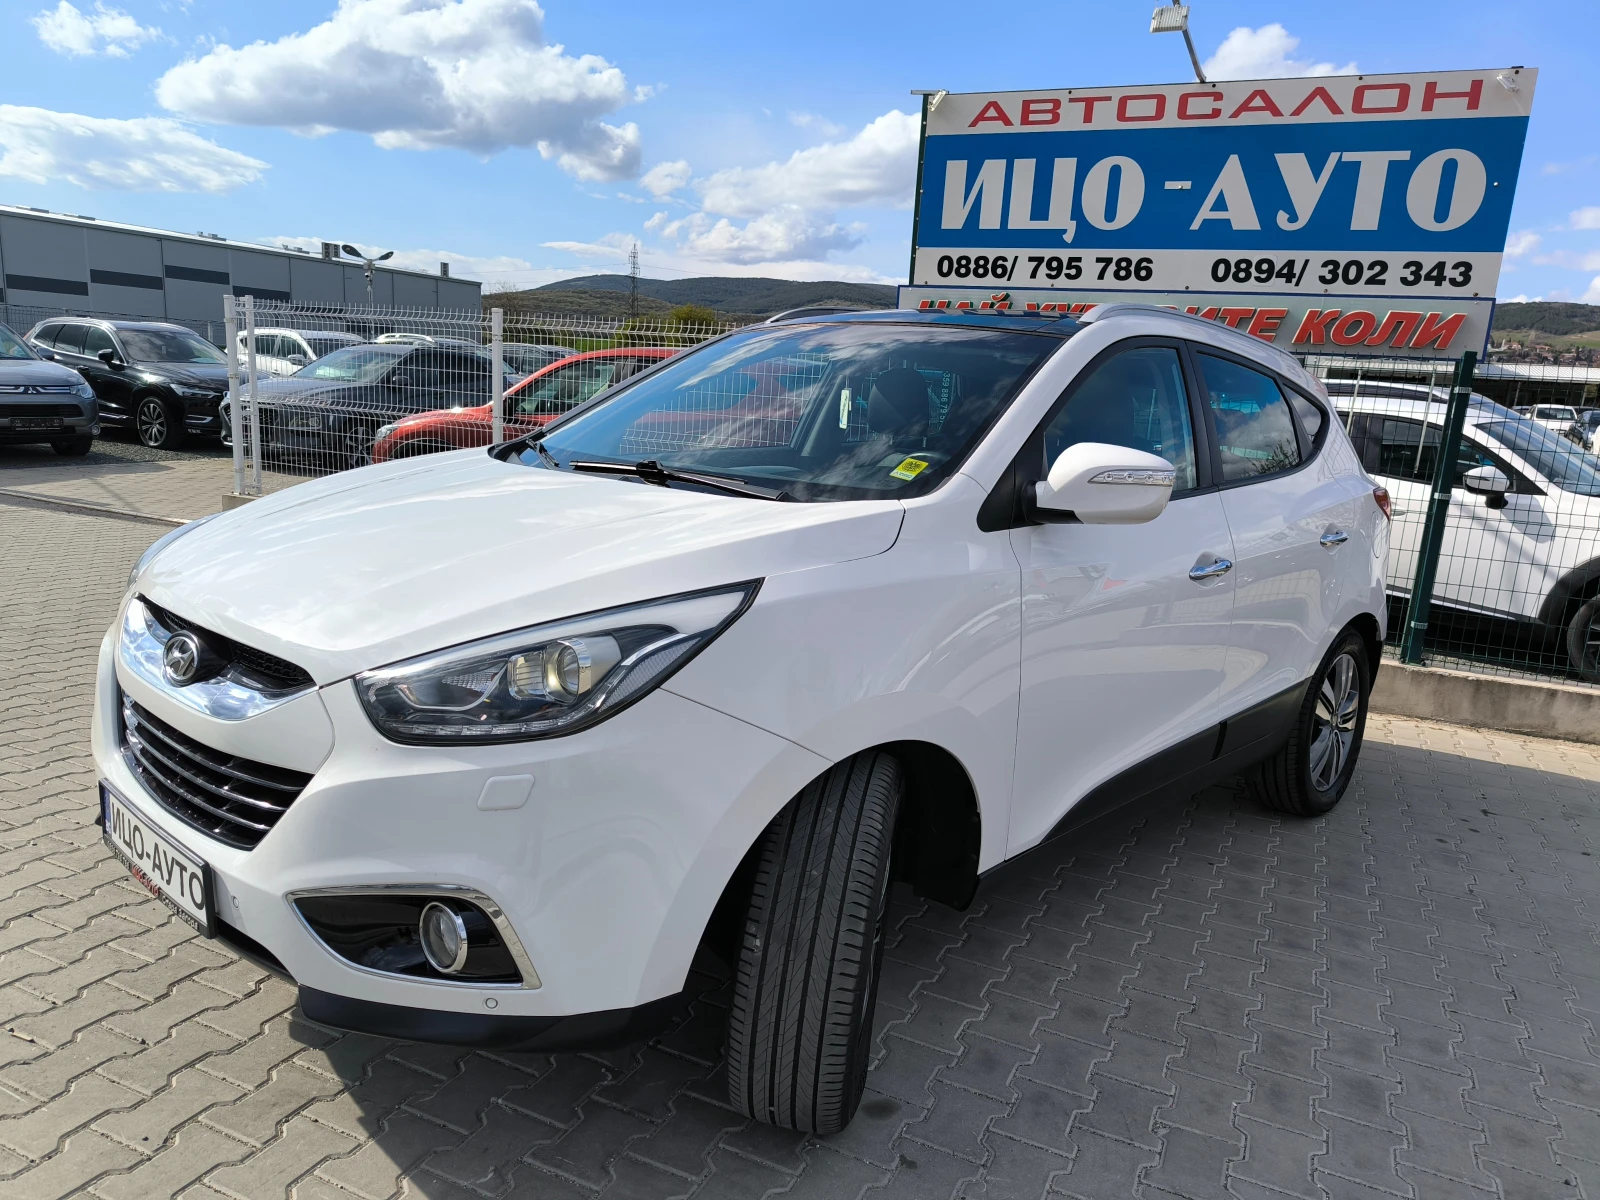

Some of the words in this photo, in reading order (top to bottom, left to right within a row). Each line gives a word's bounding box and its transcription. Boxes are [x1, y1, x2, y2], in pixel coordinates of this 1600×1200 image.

[968, 79, 1483, 127] АВТОСАЛОН
[937, 255, 1019, 282] 0886/
[1027, 256, 1083, 281] 795
[1095, 256, 1154, 282] 786
[1211, 258, 1310, 287] 0894/
[1318, 259, 1389, 286] 302
[1399, 260, 1473, 288] 343
[1292, 308, 1468, 350] КОЛИ
[111, 802, 206, 911] ИЦО-АУТО
